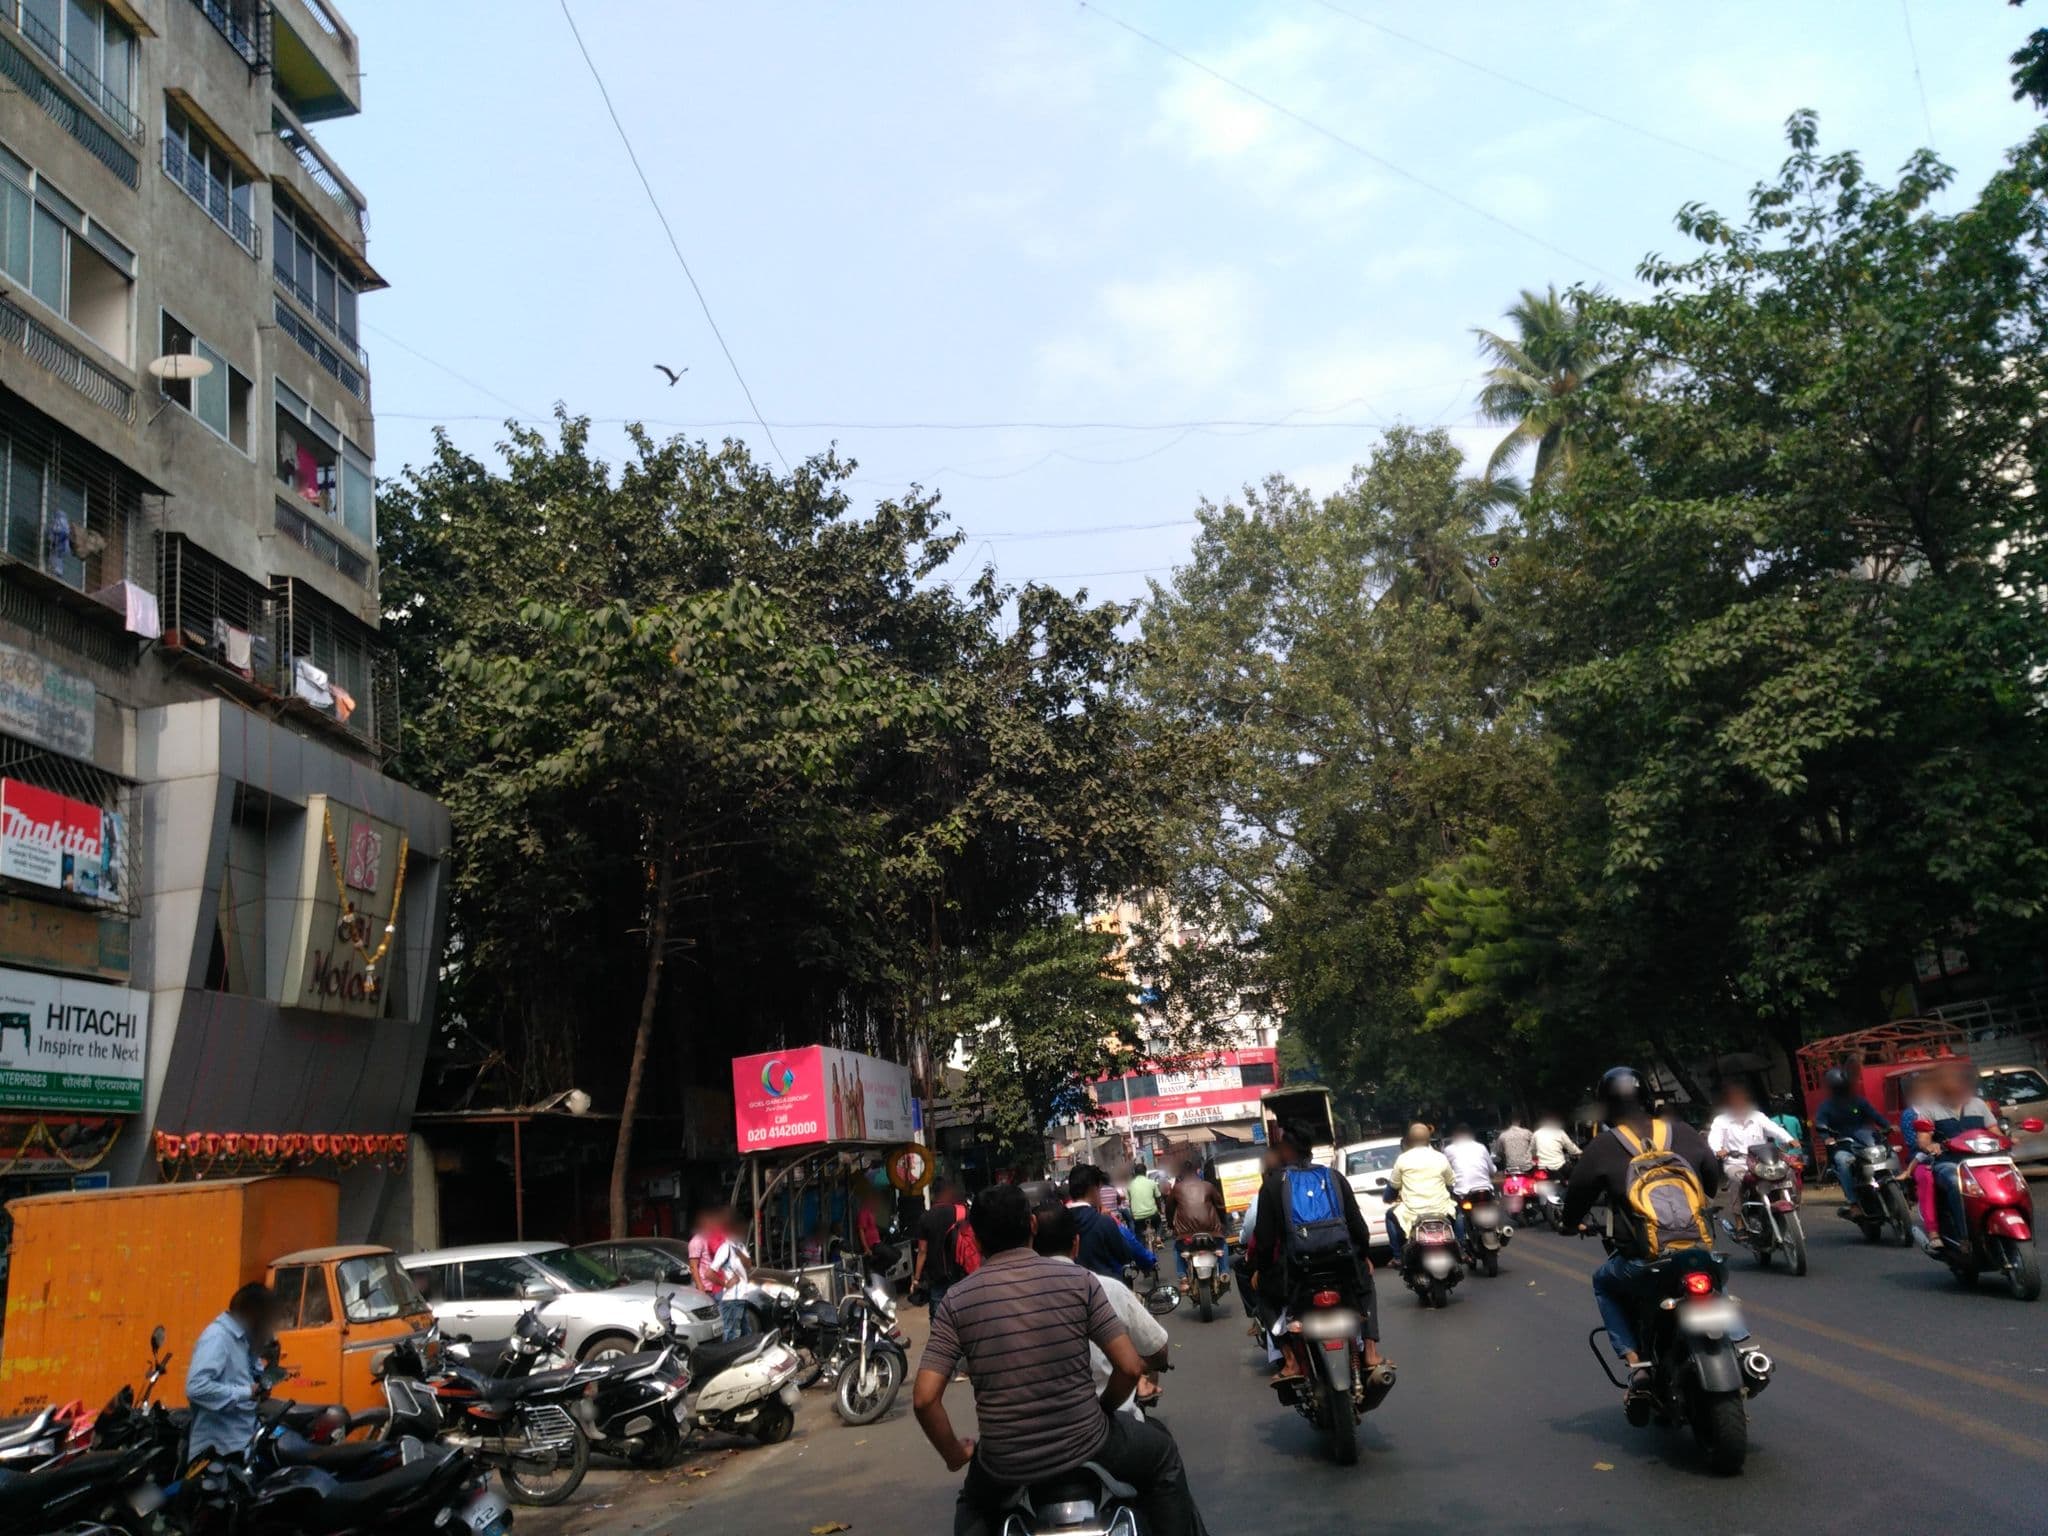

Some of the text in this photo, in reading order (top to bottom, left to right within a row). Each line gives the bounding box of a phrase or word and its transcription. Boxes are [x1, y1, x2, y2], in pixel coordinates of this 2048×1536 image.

[47, 1003, 137, 1039] HITACHI
[38, 1035, 139, 1062] Inspire the Next
[1183, 1106, 1222, 1118] AGARWAL
[747, 1121, 817, 1142] 020 41420000
